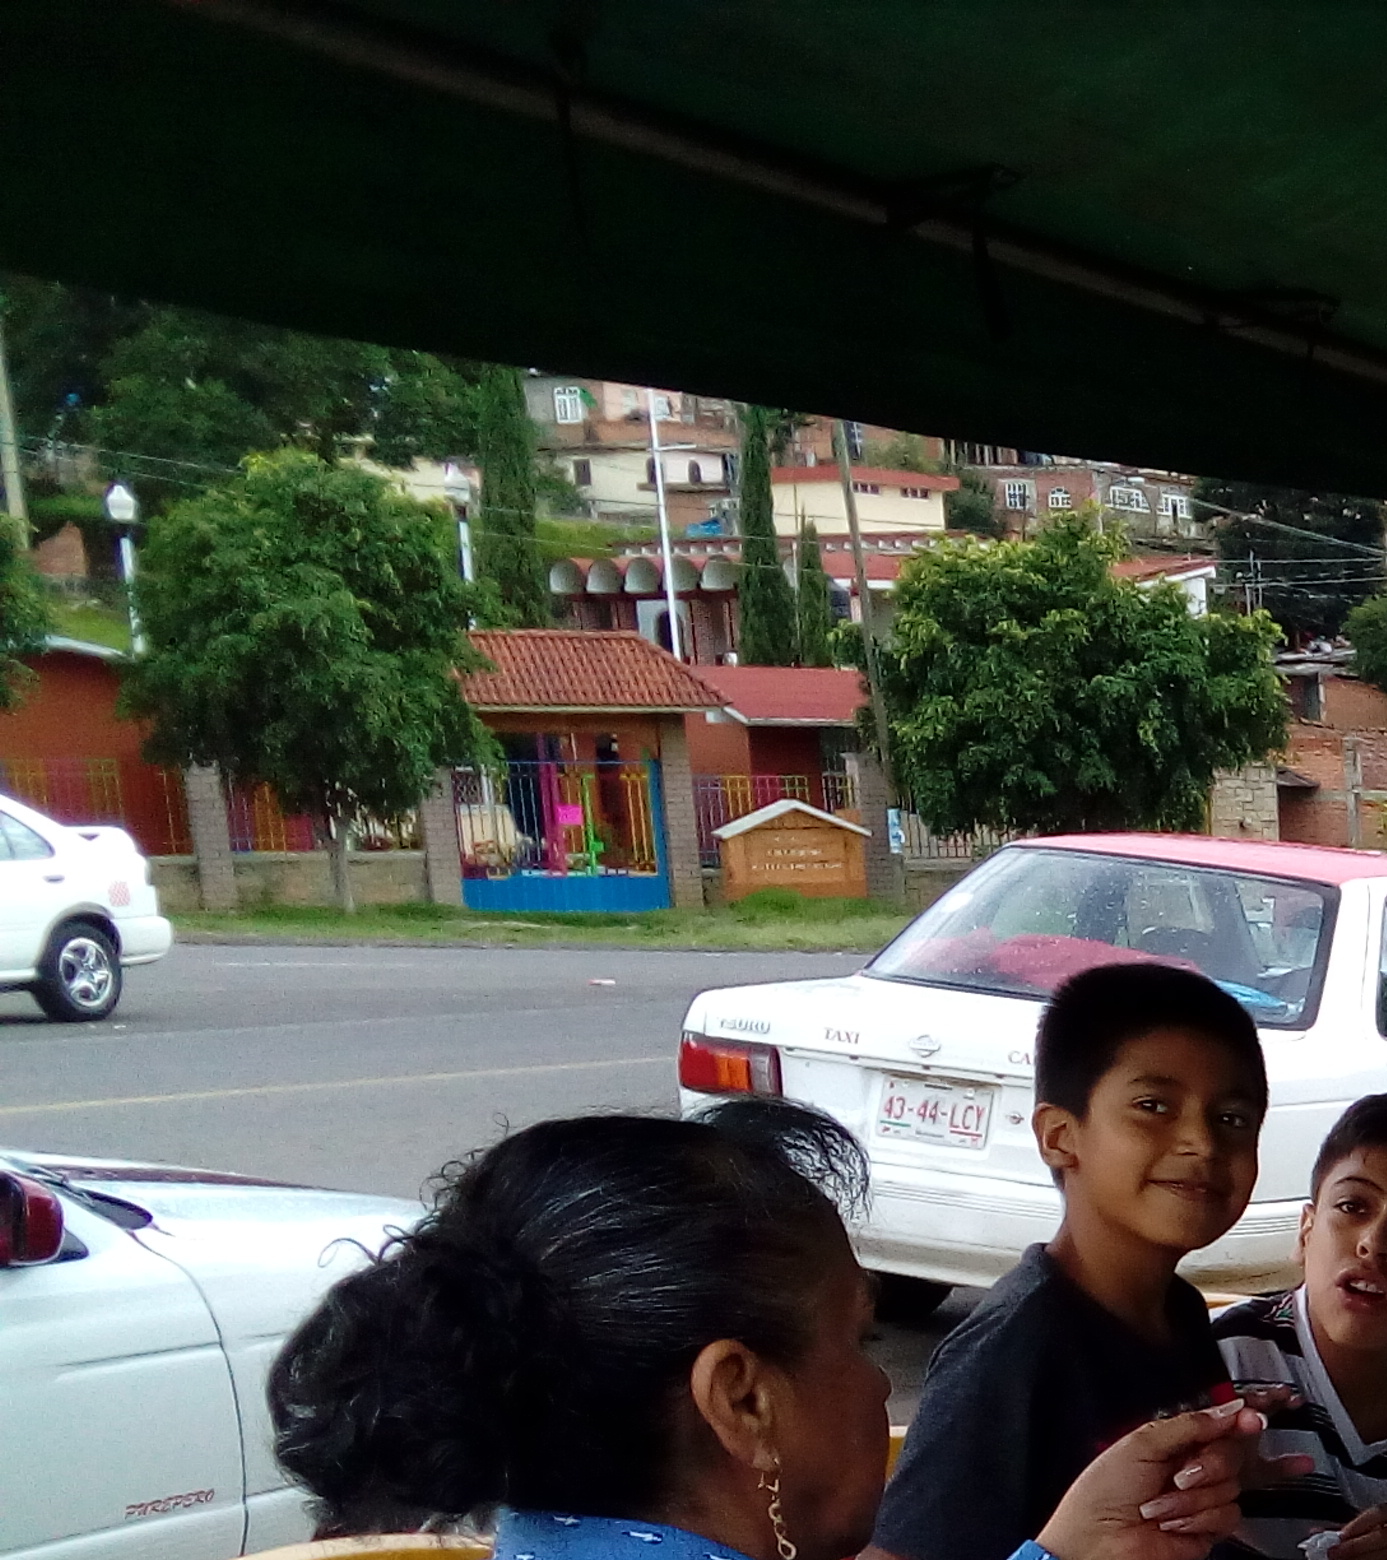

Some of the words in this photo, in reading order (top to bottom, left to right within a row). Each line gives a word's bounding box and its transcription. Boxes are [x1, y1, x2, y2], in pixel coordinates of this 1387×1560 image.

[719, 1016, 772, 1035] TSURU
[824, 1026, 861, 1046] TAXI
[883, 1095, 986, 1132] 43-44-LCY
